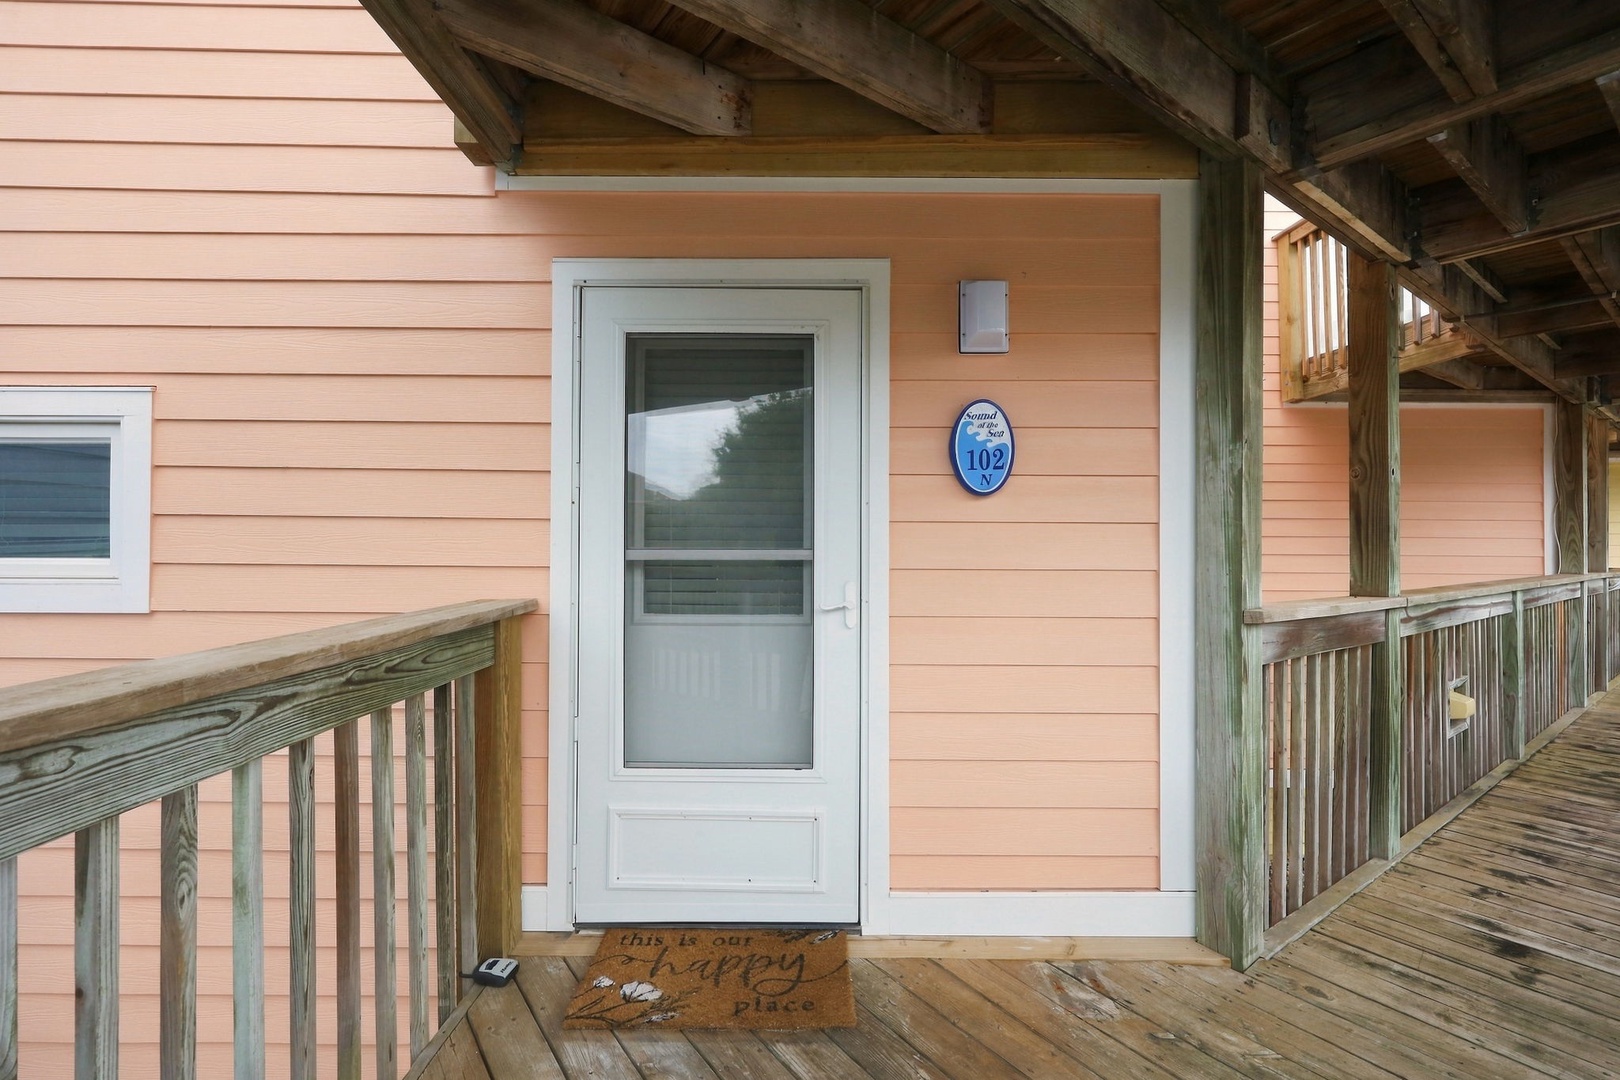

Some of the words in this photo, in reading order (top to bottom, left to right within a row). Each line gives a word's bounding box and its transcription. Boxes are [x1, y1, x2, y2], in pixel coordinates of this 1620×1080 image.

[964, 411, 997, 420] Sound
[987, 429, 1005, 437] Sea
[966, 448, 1005, 471] 102
[980, 473, 993, 486] N
[619, 933, 664, 947] this
[678, 933, 698, 947] is
[712, 935, 754, 947] our
[649, 946, 806, 997] happy
[733, 999, 816, 1017] place
